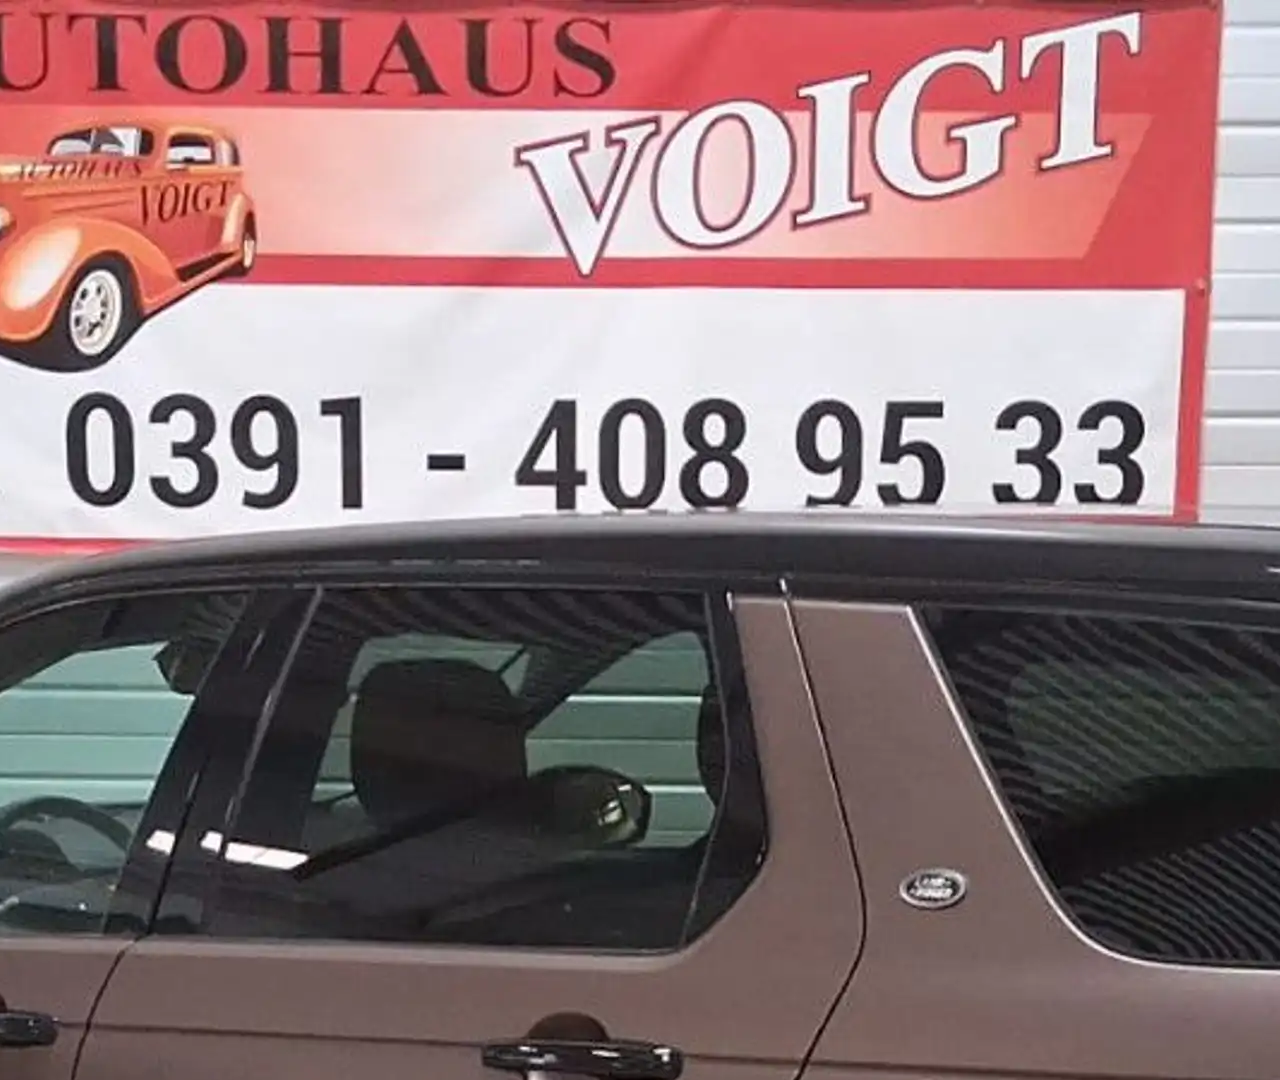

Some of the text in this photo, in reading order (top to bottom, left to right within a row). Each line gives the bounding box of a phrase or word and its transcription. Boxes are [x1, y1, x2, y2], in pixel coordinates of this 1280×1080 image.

[137, 179, 235, 226] VOIGT
[514, 11, 1142, 278] VOIGT
[65, 391, 363, 511] 0391
[514, 397, 751, 512] 408
[795, 398, 945, 508] 95
[991, 398, 1146, 508] 33
